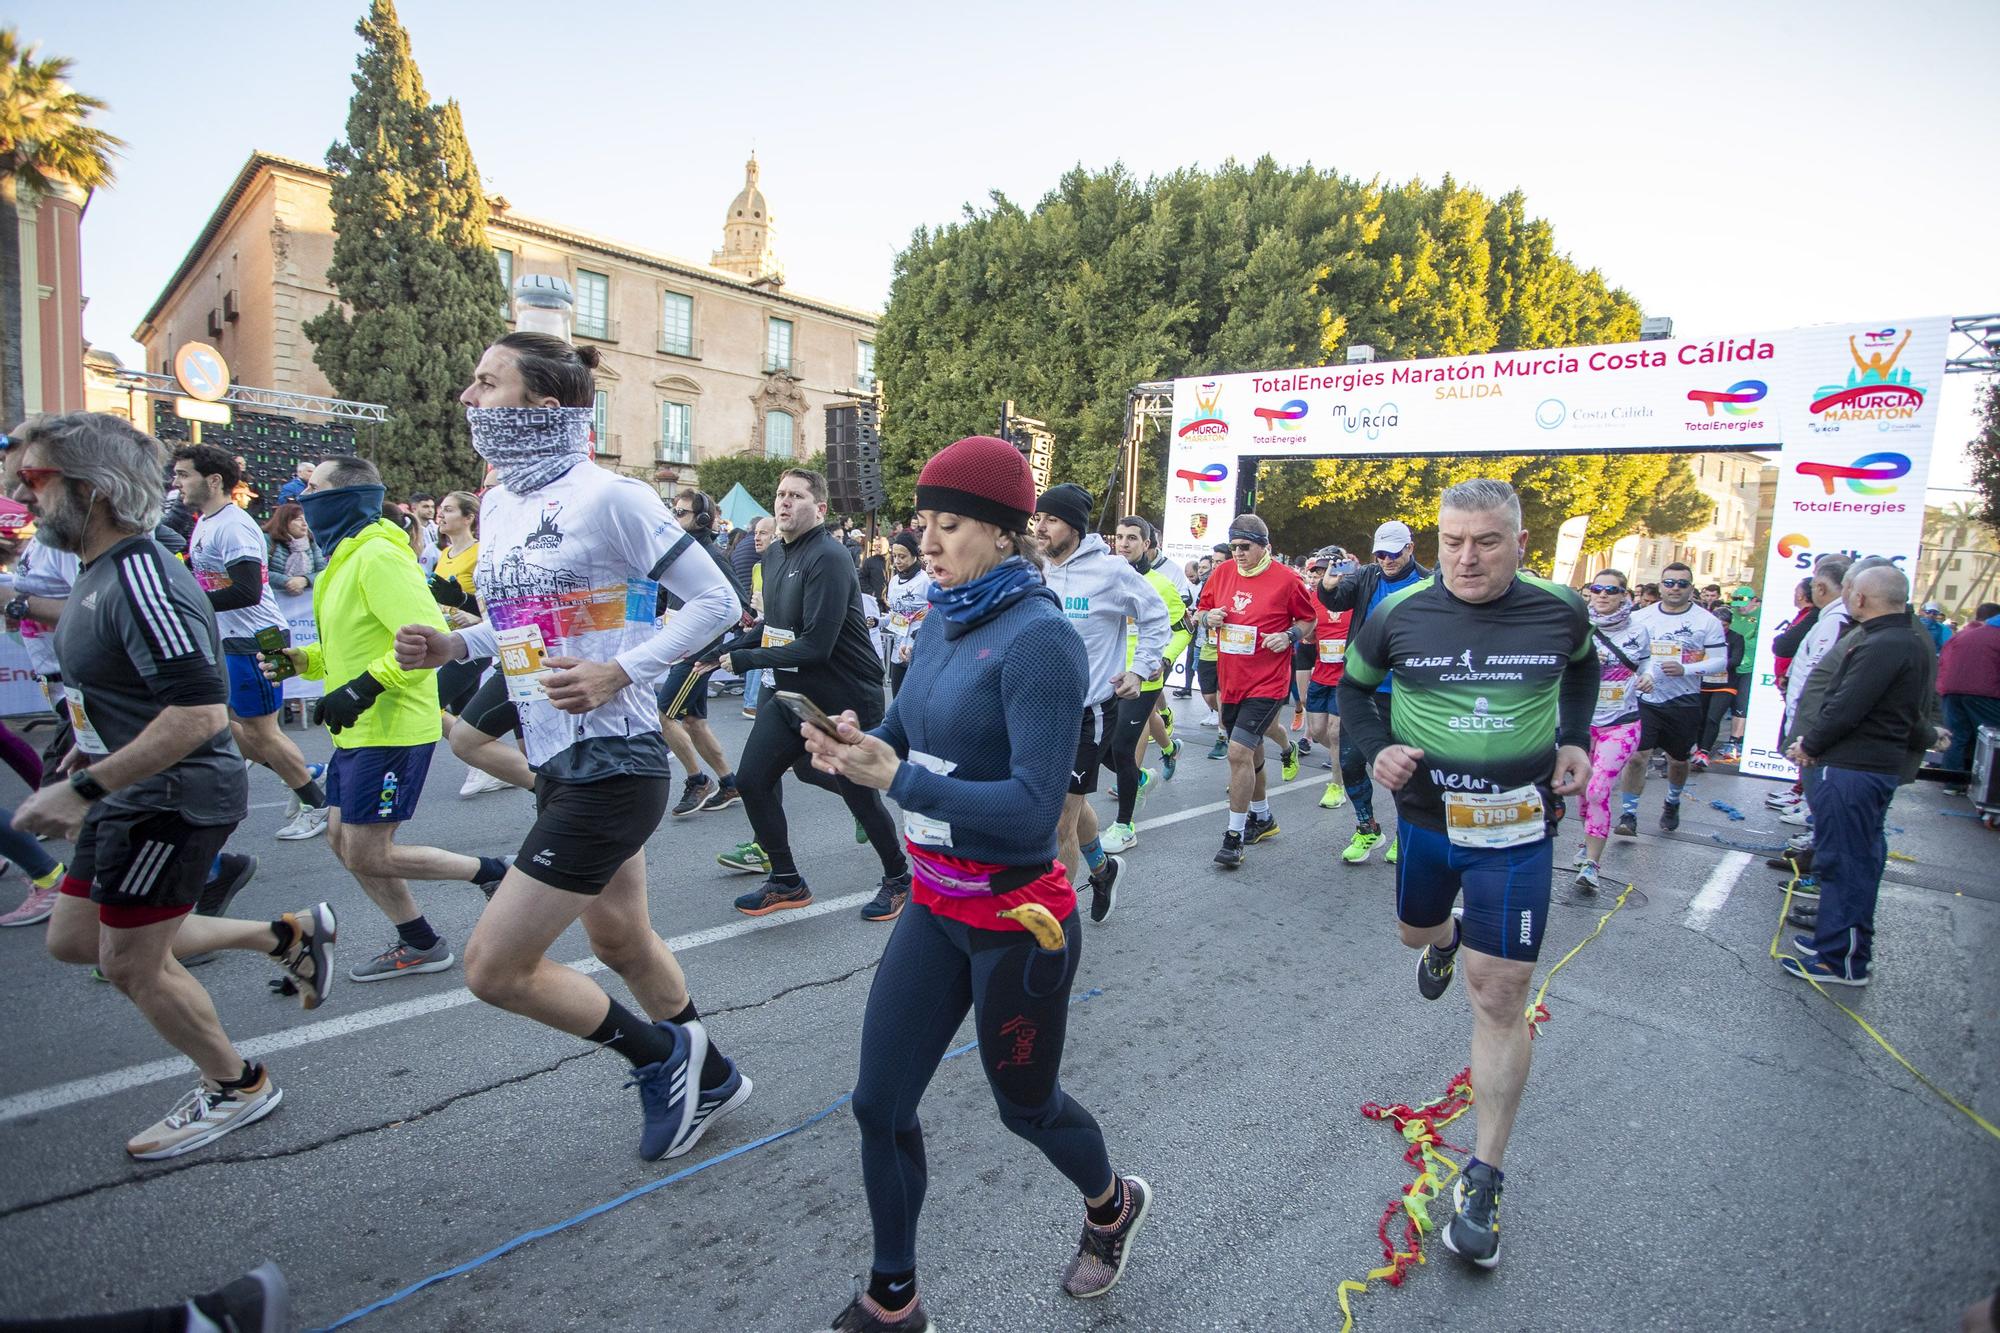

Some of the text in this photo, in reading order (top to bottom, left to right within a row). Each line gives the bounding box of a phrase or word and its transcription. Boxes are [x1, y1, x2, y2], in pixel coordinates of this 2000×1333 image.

[1252, 339, 1775, 393] TotalEnergies Maratón Murcia Costa Cálida
[1435, 384, 1503, 400] SALIDA
[1841, 395, 1916, 410] MURCIA
[1193, 426, 1227, 435] MURCIA
[1685, 420, 1764, 431] TotalEnergies
[1253, 435, 1307, 446] TotalEnergies
[1175, 495, 1227, 504] TotalEnergies
[1792, 501, 1906, 515] TotalEnergies
[1065, 597, 1089, 611] BOX
[1405, 655, 1557, 667] BLADE RUNNERS
[1439, 673, 1523, 681] CALASPARRA
[1448, 716, 1515, 728] astrac
[1747, 760, 1785, 772] CENTRO
[1472, 807, 1518, 825] 6799
